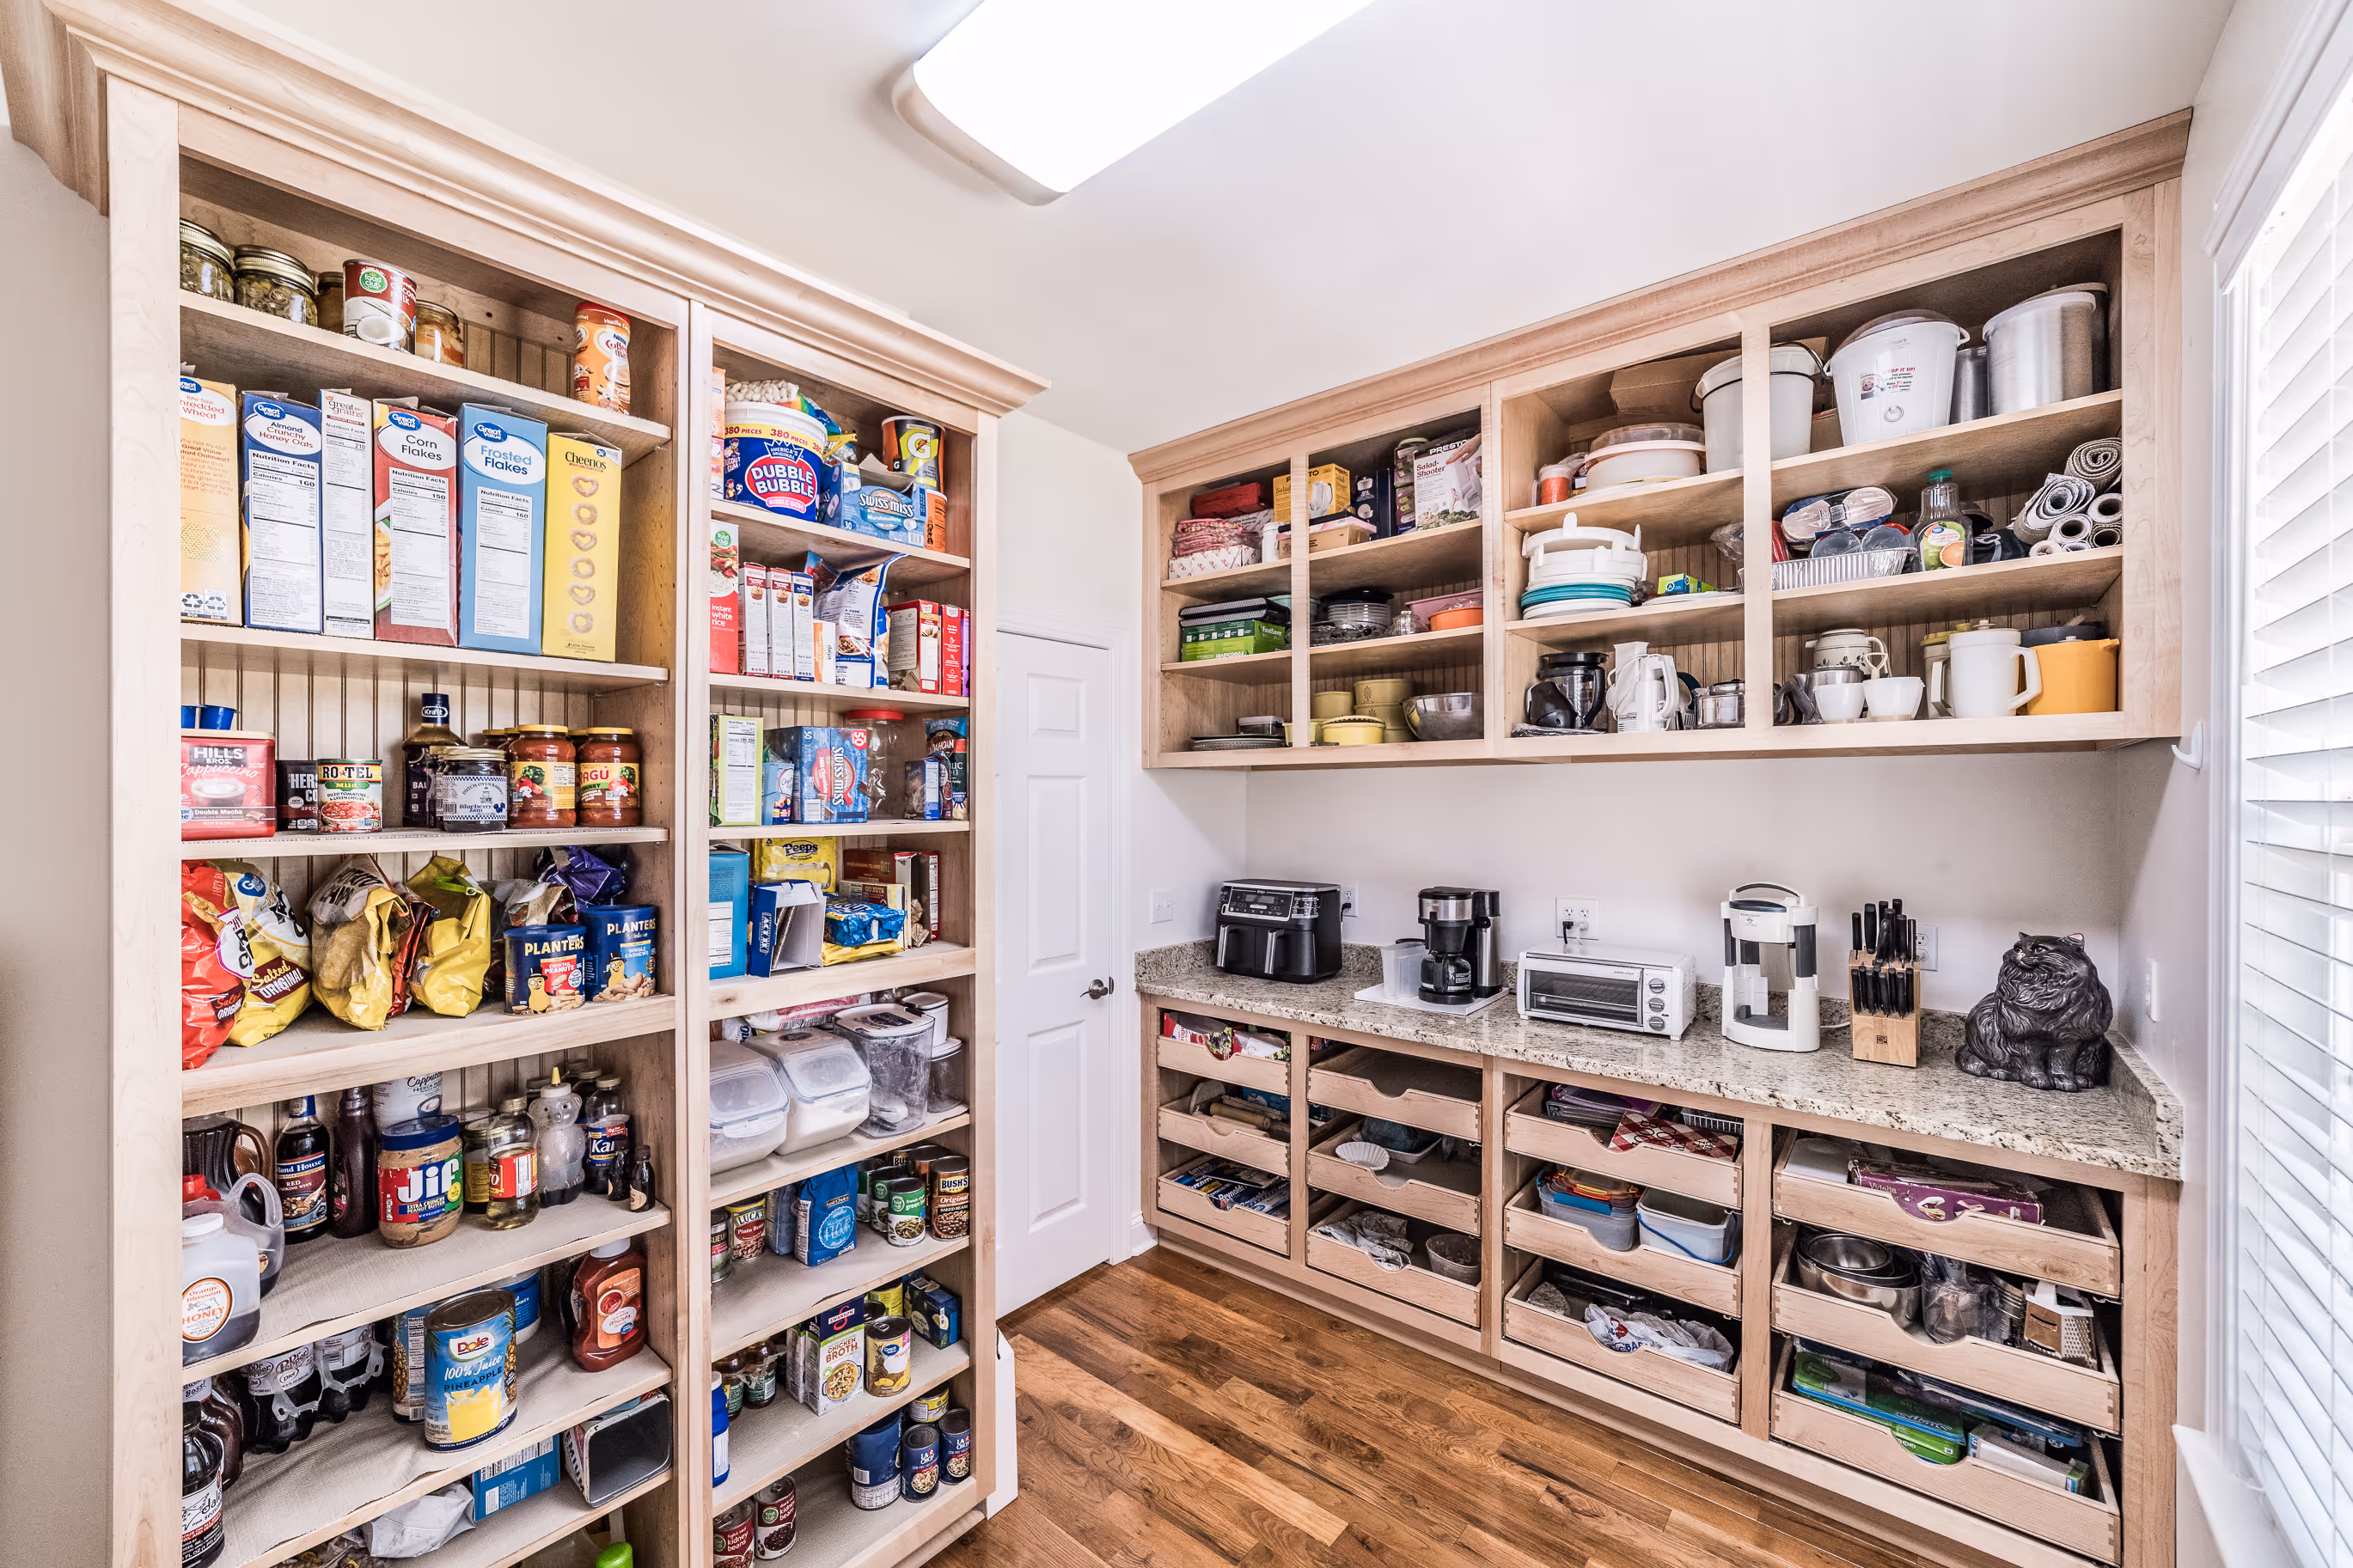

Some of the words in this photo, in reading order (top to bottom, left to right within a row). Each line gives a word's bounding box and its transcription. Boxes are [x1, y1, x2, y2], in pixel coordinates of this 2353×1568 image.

[364, 273, 382, 284] food
[364, 280, 381, 289] club
[257, 404, 280, 414] Great
[328, 400, 353, 412] great
[329, 406, 363, 418] grains
[182, 406, 217, 420] Wheat
[392, 412, 416, 425] Great
[270, 421, 303, 433] Almond
[327, 422, 350, 431] Nutrition
[398, 419, 416, 430] Value
[477, 424, 502, 436] Great
[724, 426, 740, 435] 380
[259, 430, 290, 444] Honey
[291, 438, 313, 448] Oats
[266, 426, 306, 441] Crunchy
[483, 430, 502, 442] Value
[769, 429, 790, 439] 380
[791, 436, 809, 446] PIECES
[406, 434, 437, 449] Corn
[907, 432, 931, 460] G
[1429, 439, 1470, 455] PRESTO
[197, 451, 230, 462] Oatmeal?
[203, 447, 223, 455] Value
[401, 444, 442, 461] Flakes
[480, 445, 532, 466] Frosted
[770, 446, 799, 456] AMERICA'S
[772, 452, 796, 461] ORIGINAL
[253, 452, 290, 465] Nutrition
[292, 460, 315, 470] Facts
[485, 457, 529, 476] Flakes
[565, 450, 607, 471] Cheerios
[893, 461, 901, 470] G
[1416, 460, 1439, 472] Salad-
[253, 472, 283, 481] Calories
[392, 469, 425, 481] Nutrition
[425, 477, 446, 485] Facts
[750, 464, 814, 485] DUBBLE
[1335, 465, 1349, 477] PRESTO
[1416, 465, 1446, 479] Shooter
[298, 479, 315, 488] 160
[755, 478, 815, 499] BUBBLE
[393, 487, 419, 496] Calories
[480, 490, 510, 500] Nutrition
[510, 496, 529, 504] Facts
[480, 505, 504, 515] Calories
[768, 499, 789, 508] BUBBLE
[789, 501, 805, 510] GUM
[845, 520, 853, 530] 30
[712, 603, 732, 613] instant
[712, 611, 733, 621] white
[712, 619, 726, 627] rice
[1261, 625, 1283, 637] FoodSaver
[930, 721, 946, 729] FAMILY
[947, 719, 960, 728] SIZE
[804, 730, 812, 740] 50
[854, 731, 865, 747] 50
[193, 747, 243, 760] HILLS
[180, 763, 261, 778] Cappuccino
[323, 766, 339, 779] RO
[345, 766, 373, 779] TEL
[782, 843, 818, 855] Peeps
[880, 859, 891, 874] RITZ
[607, 918, 656, 936] PLANTERS
[524, 936, 585, 957] PLANTERS
[625, 950, 649, 959] CASHEWS
[251, 960, 291, 990] Salted
[544, 964, 574, 974] PEANUTS
[259, 967, 304, 999] ORIGINAL
[413, 1084, 433, 1093] FRENCH
[296, 1160, 322, 1172] House
[298, 1181, 313, 1190] WINE
[397, 1157, 460, 1204] Jif
[942, 1176, 968, 1189] BUSH'S
[1218, 1185, 1244, 1201] Reynolds
[1867, 1181, 1896, 1193] Vidalia
[406, 1201, 425, 1210] EXTRA
[425, 1196, 445, 1206] CRUNCHY
[939, 1193, 969, 1205] Original
[407, 1205, 427, 1215] PEANUT
[427, 1200, 445, 1211] BUTTER
[905, 1203, 920, 1211] green
[186, 1290, 222, 1303] Blossom
[189, 1285, 219, 1296] Orange
[182, 1306, 225, 1325] HONEY
[608, 1313, 631, 1327] Ketchup
[829, 1309, 854, 1324] SWANSON
[457, 1336, 490, 1354] Dole
[828, 1337, 856, 1355] CHICKEN
[883, 1345, 897, 1354] Great
[289, 1348, 302, 1363] Dr
[825, 1342, 858, 1364] BROTH
[279, 1349, 309, 1373] Pepper
[443, 1364, 473, 1382] 100%
[472, 1355, 503, 1376] Juice
[284, 1371, 296, 1382] Diet
[443, 1365, 503, 1392] PINEAPPLE
[185, 1379, 206, 1398] Boss!
[455, 1437, 477, 1448] GOODNESS
[956, 1441, 970, 1450] CHOY
[920, 1454, 935, 1465] CHOY
[779, 1501, 795, 1516] kidney
[779, 1509, 794, 1522] beans
[727, 1531, 739, 1541] light
[727, 1531, 749, 1546] kidney
[727, 1540, 747, 1552] beans
